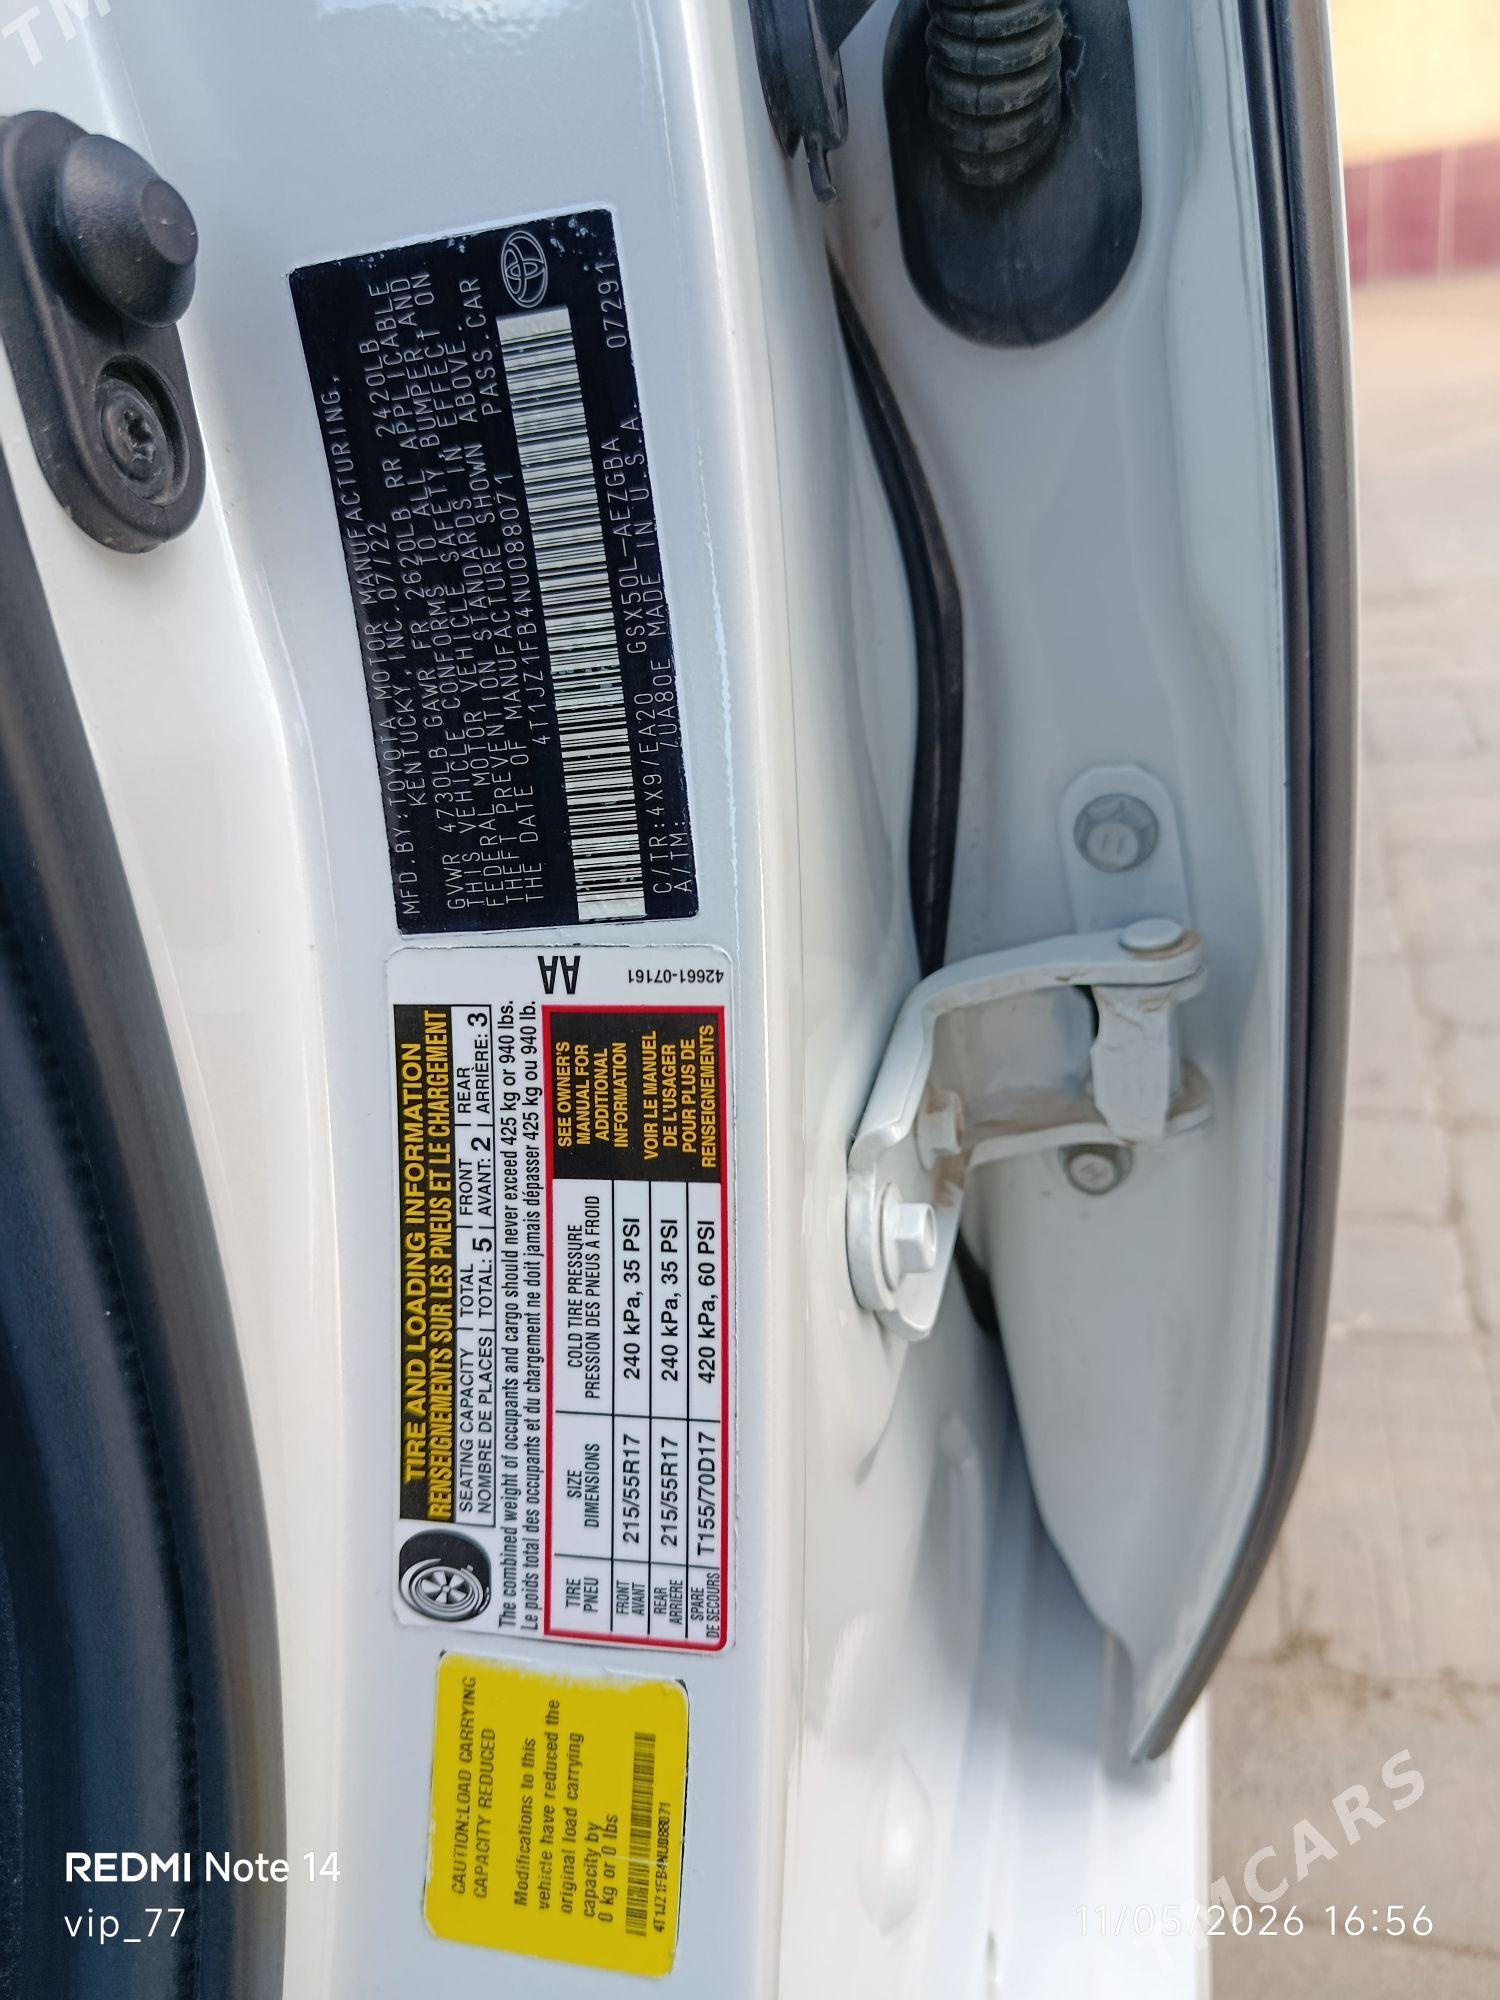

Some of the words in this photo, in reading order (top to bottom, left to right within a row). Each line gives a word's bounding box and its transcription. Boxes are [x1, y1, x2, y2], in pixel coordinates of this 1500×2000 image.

[410, 273, 435, 307] ON
[367, 281, 419, 452] APPLICABLE
[419, 326, 458, 428] EFFECT
[441, 324, 478, 425] ABOVE.
[358, 339, 396, 438] 2420LB
[381, 458, 405, 490] RR
[441, 447, 465, 474] IN
[405, 470, 431, 519] ALL
[463, 443, 496, 525] SHOWN
[391, 509, 424, 600] 2620LB
[416, 537, 439, 566] TO
[633, 522, 655, 548] IN
[451, 499, 492, 642] STANDARDS
[640, 572, 667, 638] MADE
[409, 621, 432, 650] FR
[424, 585, 461, 710] CONFORMS
[443, 583, 479, 693] VEHICLE
[480, 544, 524, 720] MANUFACTURE
[363, 623, 393, 700] MOTOR
[417, 669, 443, 729] GAWR
[462, 711, 491, 787] MOTOR
[476, 662, 515, 814] PREVENTION
[507, 739, 529, 766] OF
[427, 747, 457, 834] 4730LB
[445, 729, 477, 834] VEHICLE
[513, 786, 538, 843] DATE
[475, 804, 505, 907] FEDERAL
[498, 834, 525, 904] THEFT
[441, 854, 467, 910] GVWR
[461, 852, 485, 907] THIS
[522, 863, 544, 903] THE
[537, 955, 582, 995] AA
[626, 968, 724, 983] 42661-07161
[467, 1013, 487, 1028] 3
[497, 1001, 513, 1029] lbs.
[519, 1001, 535, 1021] lb.
[499, 1035, 514, 1064] 940
[521, 1026, 536, 1055] 940
[574, 1045, 589, 1076] FOR
[680, 1039, 695, 1059] DE
[424, 1010, 450, 1138] CHARGEMENT
[471, 1034, 490, 1114] ARRIÈRE:
[503, 1069, 515, 1086] or
[525, 1060, 537, 1081] ou
[556, 1042, 571, 1113] OWNER'S
[641, 1031, 658, 1095] MANUEL
[661, 1044, 676, 1122] L'USAGER
[456, 1067, 470, 1114] REAR
[500, 1092, 520, 1112] kg
[521, 1087, 542, 1106] kg
[592, 1049, 610, 1142] ADDITIONAL
[612, 1042, 628, 1148] INFORMATION
[681, 1064, 695, 1105] PLUS
[699, 1025, 717, 1168] RENSEIGNEMENTS
[523, 1112, 539, 1141] 425
[575, 1080, 591, 1145] MANUAL
[643, 1100, 658, 1119] LE
[401, 1043, 425, 1225] INFORMATION
[470, 1137, 490, 1152] 2
[500, 1117, 516, 1146] 425
[558, 1118, 572, 1148] SEE
[644, 1122, 659, 1160] VOIR
[662, 1126, 677, 1147] DE
[682, 1109, 696, 1153] POUR
[428, 1143, 450, 1164] LE
[429, 1169, 450, 1192] ET
[458, 1159, 472, 1216] FRONT
[478, 1158, 491, 1217] AVANT:
[500, 1151, 517, 1200] exceed
[522, 1145, 543, 1207] dépasser
[429, 1198, 451, 1258] PNEUS
[504, 1205, 517, 1245] never
[522, 1211, 543, 1258] jamais
[584, 1196, 599, 1236] FROID
[622, 1218, 639, 1253] PSI
[660, 1219, 677, 1254] PSI
[472, 1238, 492, 1253] 5
[697, 1220, 715, 1255] PSI
[501, 1251, 518, 1298] should
[523, 1261, 540, 1287] doit
[567, 1224, 583, 1295] PRESSURE
[585, 1254, 600, 1297] PNEUS
[623, 1260, 639, 1284] 35
[661, 1261, 677, 1285] 35
[697, 1262, 715, 1287] 60
[404, 1232, 426, 1353] LOADING
[430, 1264, 452, 1299] LES
[460, 1264, 473, 1318] TOTAL
[479, 1260, 492, 1319] TOTAL:
[526, 1291, 540, 1308] ne
[430, 1304, 452, 1343] SUR
[505, 1303, 520, 1344] cargo
[567, 1300, 583, 1327] TIRE
[585, 1302, 600, 1327] DES
[623, 1291, 643, 1336] kPa,
[661, 1293, 681, 1337] kPa,
[698, 1294, 718, 1340] kPa,
[478, 1336, 492, 1405] PLACES
[501, 1348, 517, 1374] and
[523, 1313, 543, 1393] chargement
[567, 1333, 582, 1369] COLD
[584, 1332, 600, 1400] PRESSION
[623, 1343, 640, 1380] 240
[661, 1345, 678, 1383] 240
[697, 1346, 715, 1384] 420
[406, 1359, 426, 1415] AND
[459, 1348, 473, 1433] CAPACITY
[523, 1398, 539, 1414] du
[430, 1348, 452, 1517] RENSEIGNEMENTS
[478, 1410, 492, 1433] DE
[503, 1378, 520, 1450] occupants
[524, 1419, 539, 1431] et
[406, 1422, 426, 1483] TIRE
[501, 1455, 518, 1468] of
[524, 1436, 543, 1504] occupants
[459, 1439, 473, 1512] SEATING
[477, 1439, 492, 1514] NOMBRE
[567, 1469, 582, 1499] SIZE
[584, 1443, 600, 1528] DIMENSIONS
[622, 1434, 640, 1544] 215/55R17
[660, 1436, 678, 1548] 215/55R17
[697, 1431, 716, 1557] T155/70D17
[500, 1473, 518, 1522] weight
[522, 1509, 539, 1534] des
[498, 1527, 517, 1598] combined
[522, 1538, 538, 1569] total
[522, 1572, 540, 1610] poids
[565, 1578, 581, 1608] TIRE
[583, 1577, 599, 1614] PNEU
[616, 1580, 629, 1616] FRONT
[631, 1582, 645, 1616] AVANT
[654, 1587, 667, 1616] REAR
[690, 1587, 704, 1622] SPARE
[498, 1601, 516, 1629] The
[521, 1614, 537, 1631] Le
[544, 1699, 560, 1727] the
[478, 1728, 495, 1810] REDUCED
[520, 1737, 535, 1770] this
[540, 1732, 559, 1799] reduced
[539, 1805, 555, 1845] have
[473, 1814, 491, 1899] CAPACITY
[513, 1795, 533, 1907] Modifications
